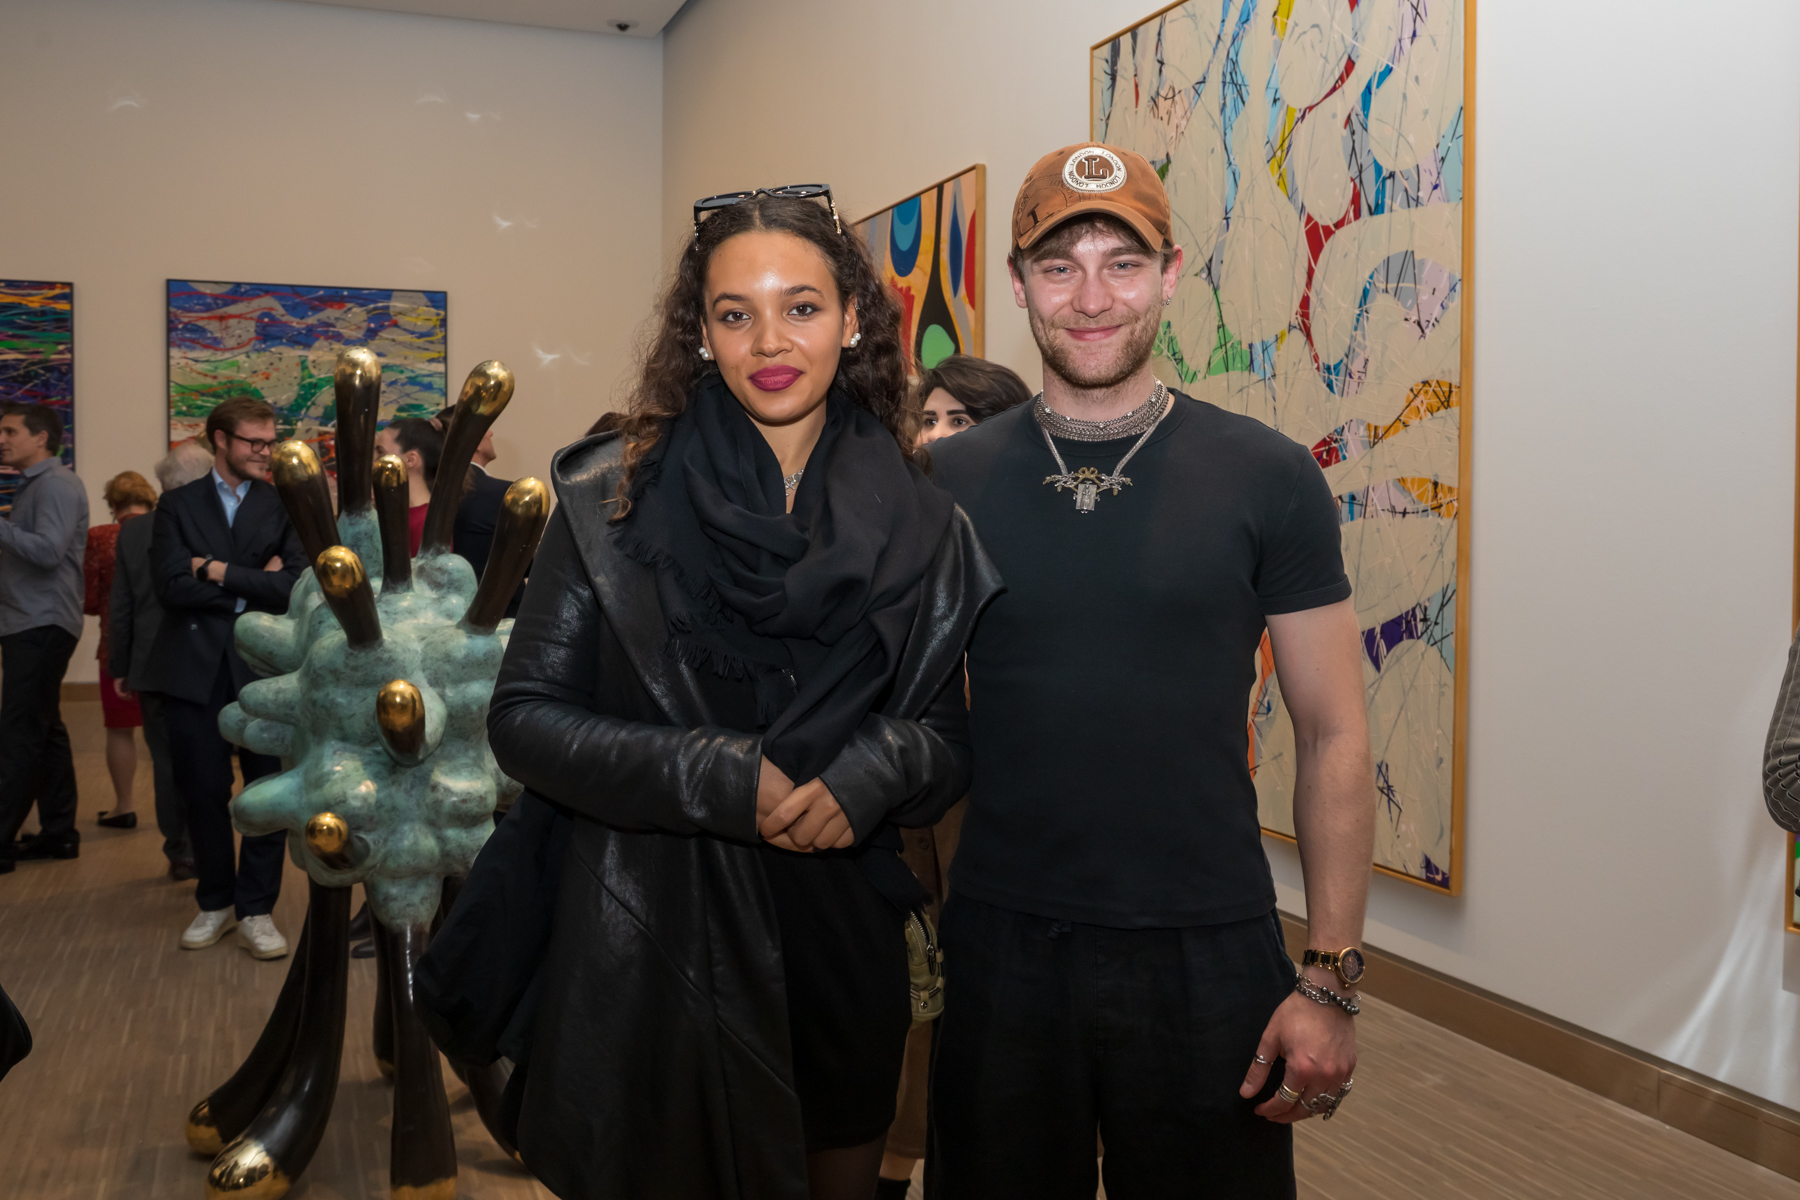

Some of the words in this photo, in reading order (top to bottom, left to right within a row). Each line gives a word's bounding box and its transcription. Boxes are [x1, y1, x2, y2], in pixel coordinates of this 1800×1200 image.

[1069, 150, 1095, 166] LONDON
[1101, 150, 1122, 172] LONDON
[1083, 157, 1109, 180] L
[1068, 170, 1089, 188] LONDON
[1095, 175, 1121, 189] LONDON
